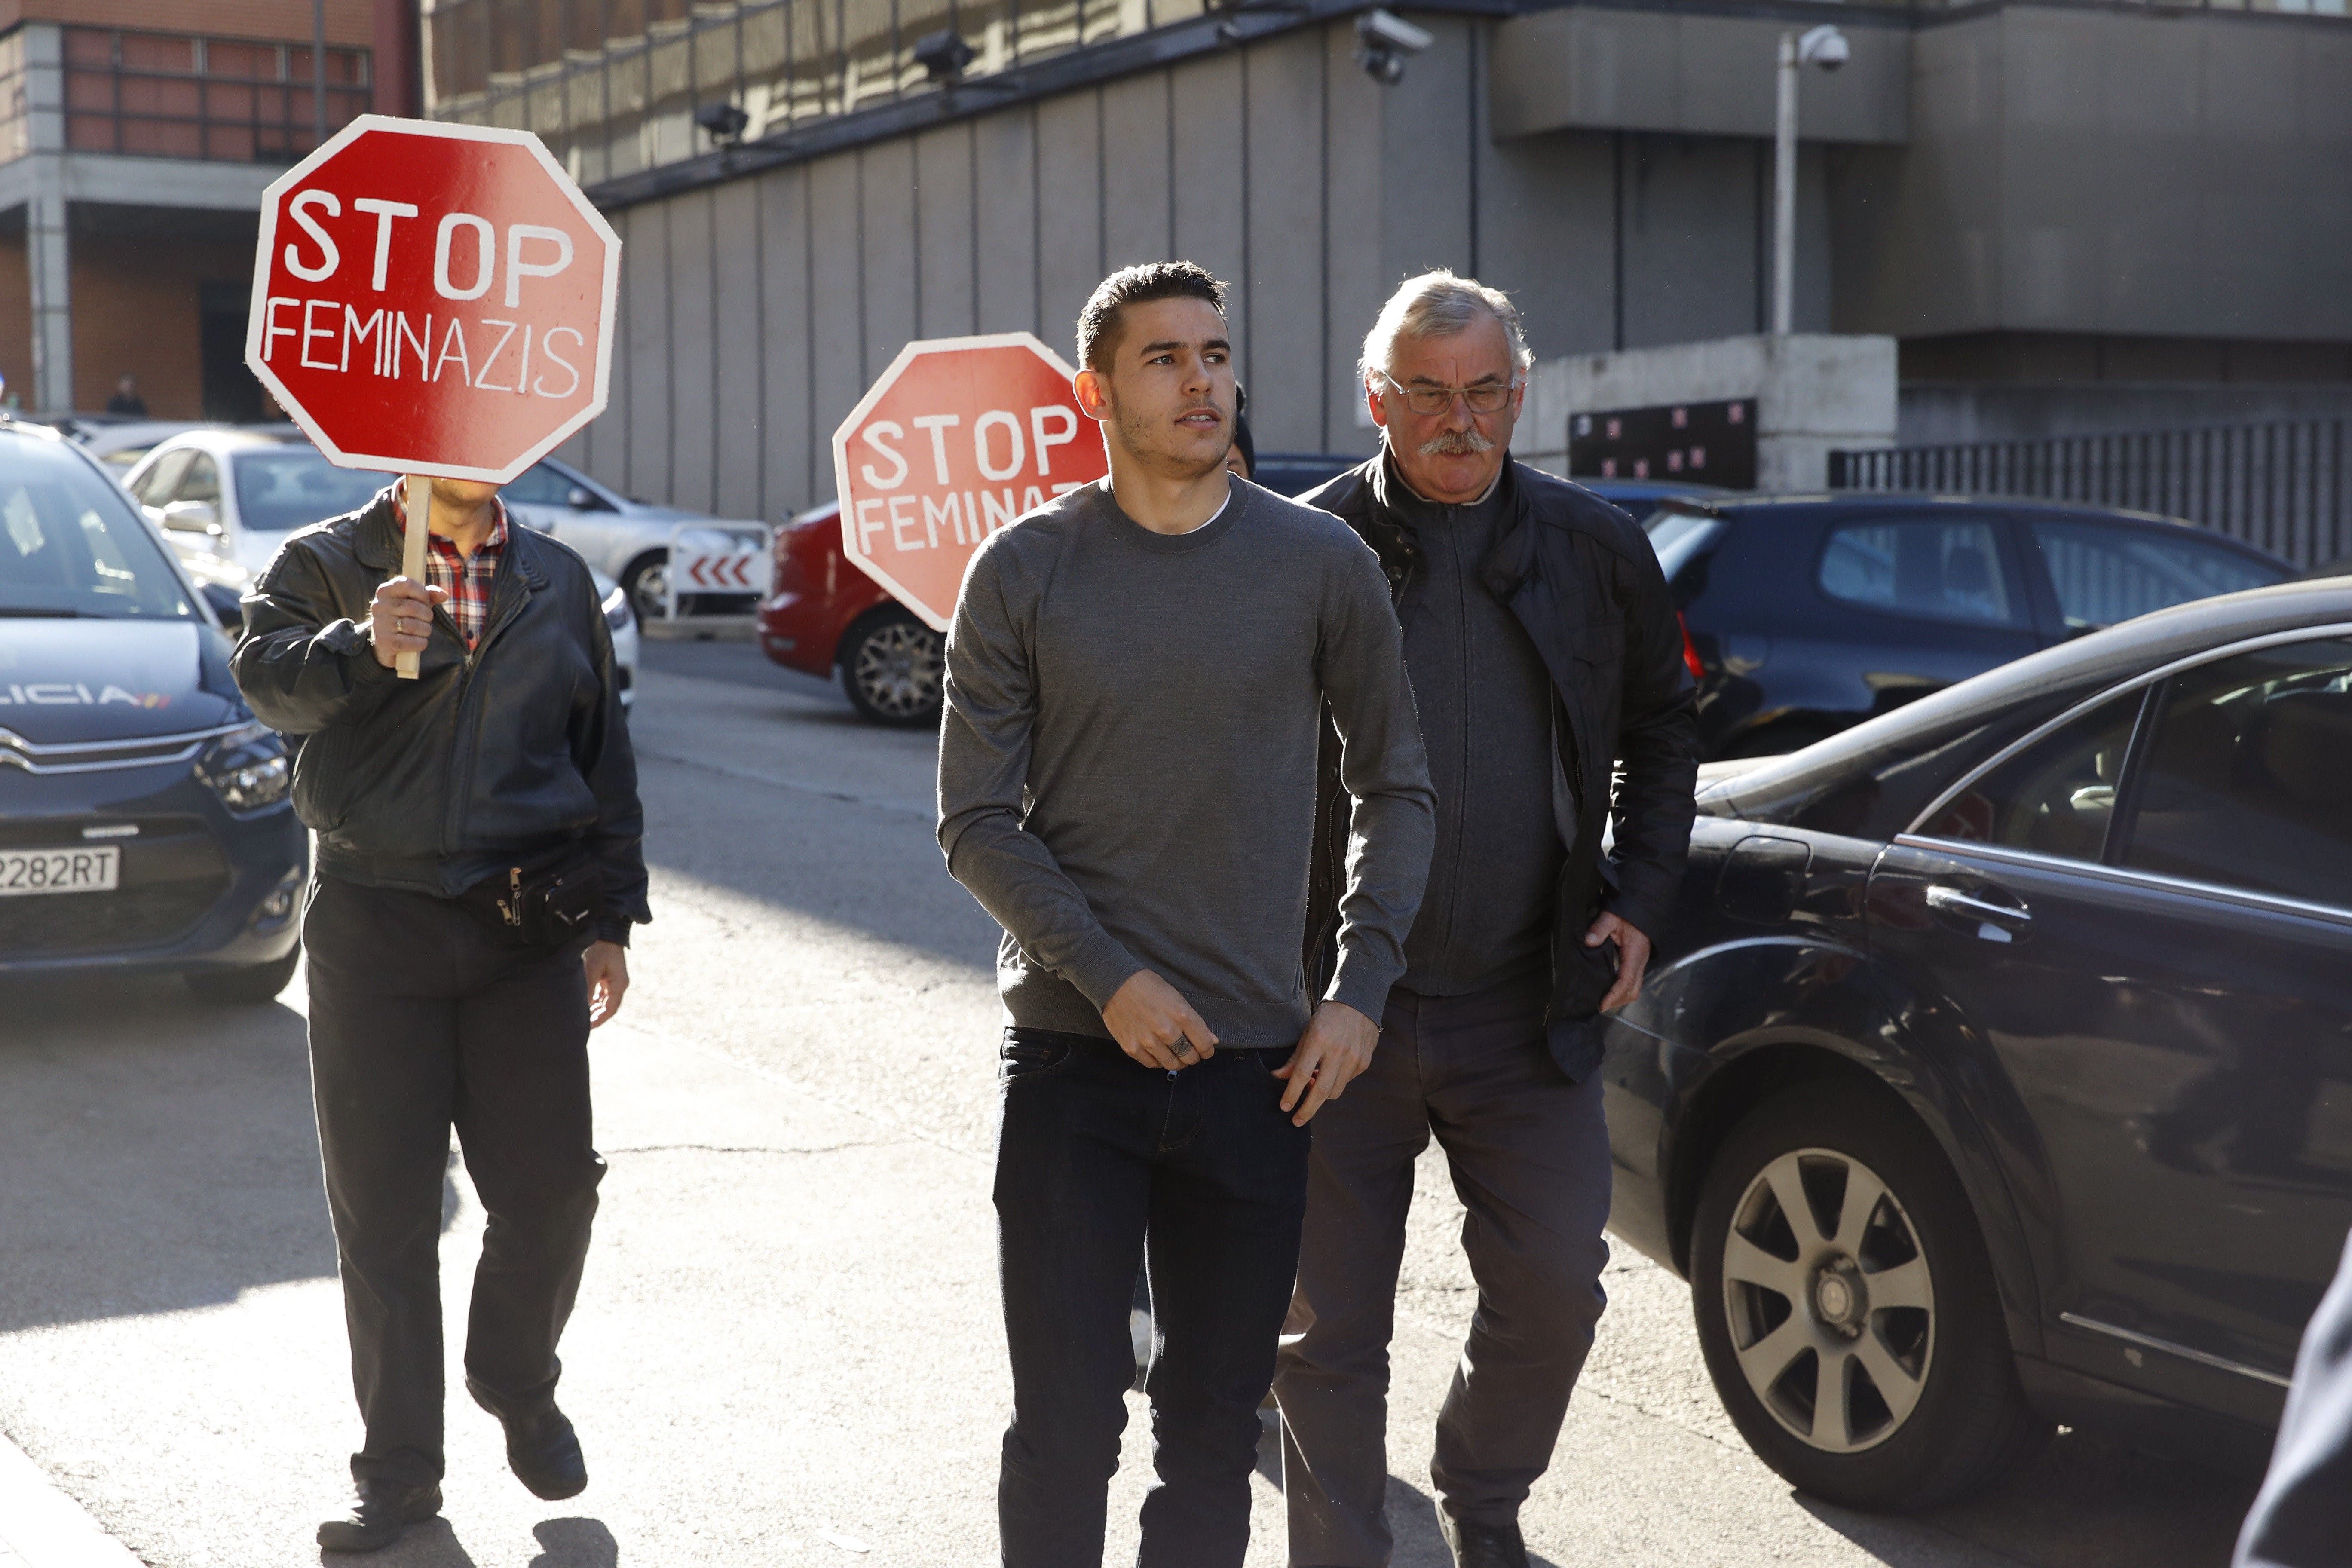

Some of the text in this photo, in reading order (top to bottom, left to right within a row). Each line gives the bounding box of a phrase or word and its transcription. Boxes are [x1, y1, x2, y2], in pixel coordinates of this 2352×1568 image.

[285, 190, 574, 308] STOP
[264, 297, 583, 399] FEMINAZIS
[861, 404, 1078, 490] STOP
[856, 482, 1083, 555] FEMIN
[0, 683, 141, 705] ICIA
